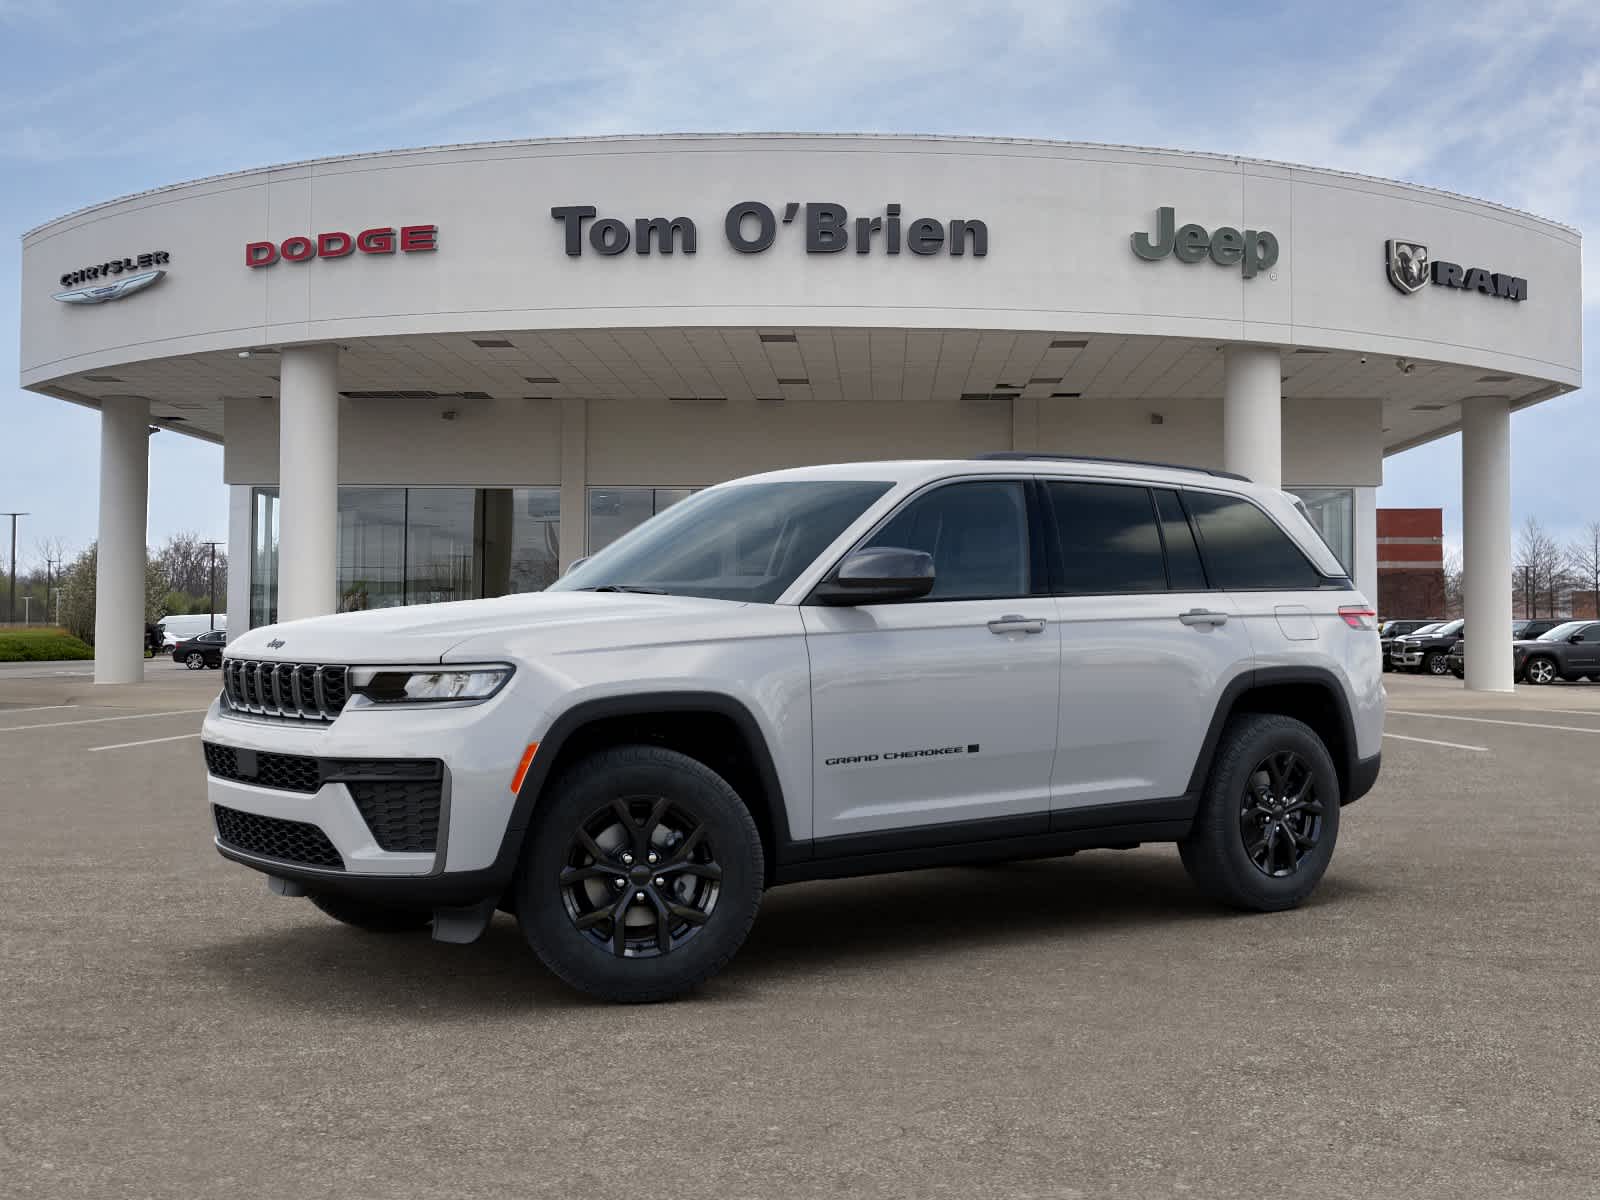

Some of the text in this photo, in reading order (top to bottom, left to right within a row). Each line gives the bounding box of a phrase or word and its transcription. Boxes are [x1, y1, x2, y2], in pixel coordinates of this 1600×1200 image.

[246, 224, 437, 269] DODGE
[551, 201, 988, 257] Tom O'Brien
[1130, 206, 1280, 279] Jeep
[60, 250, 170, 287] CHRYSLER
[1431, 260, 1528, 301] RAM
[825, 746, 963, 766] GRAND CHEROKEE
